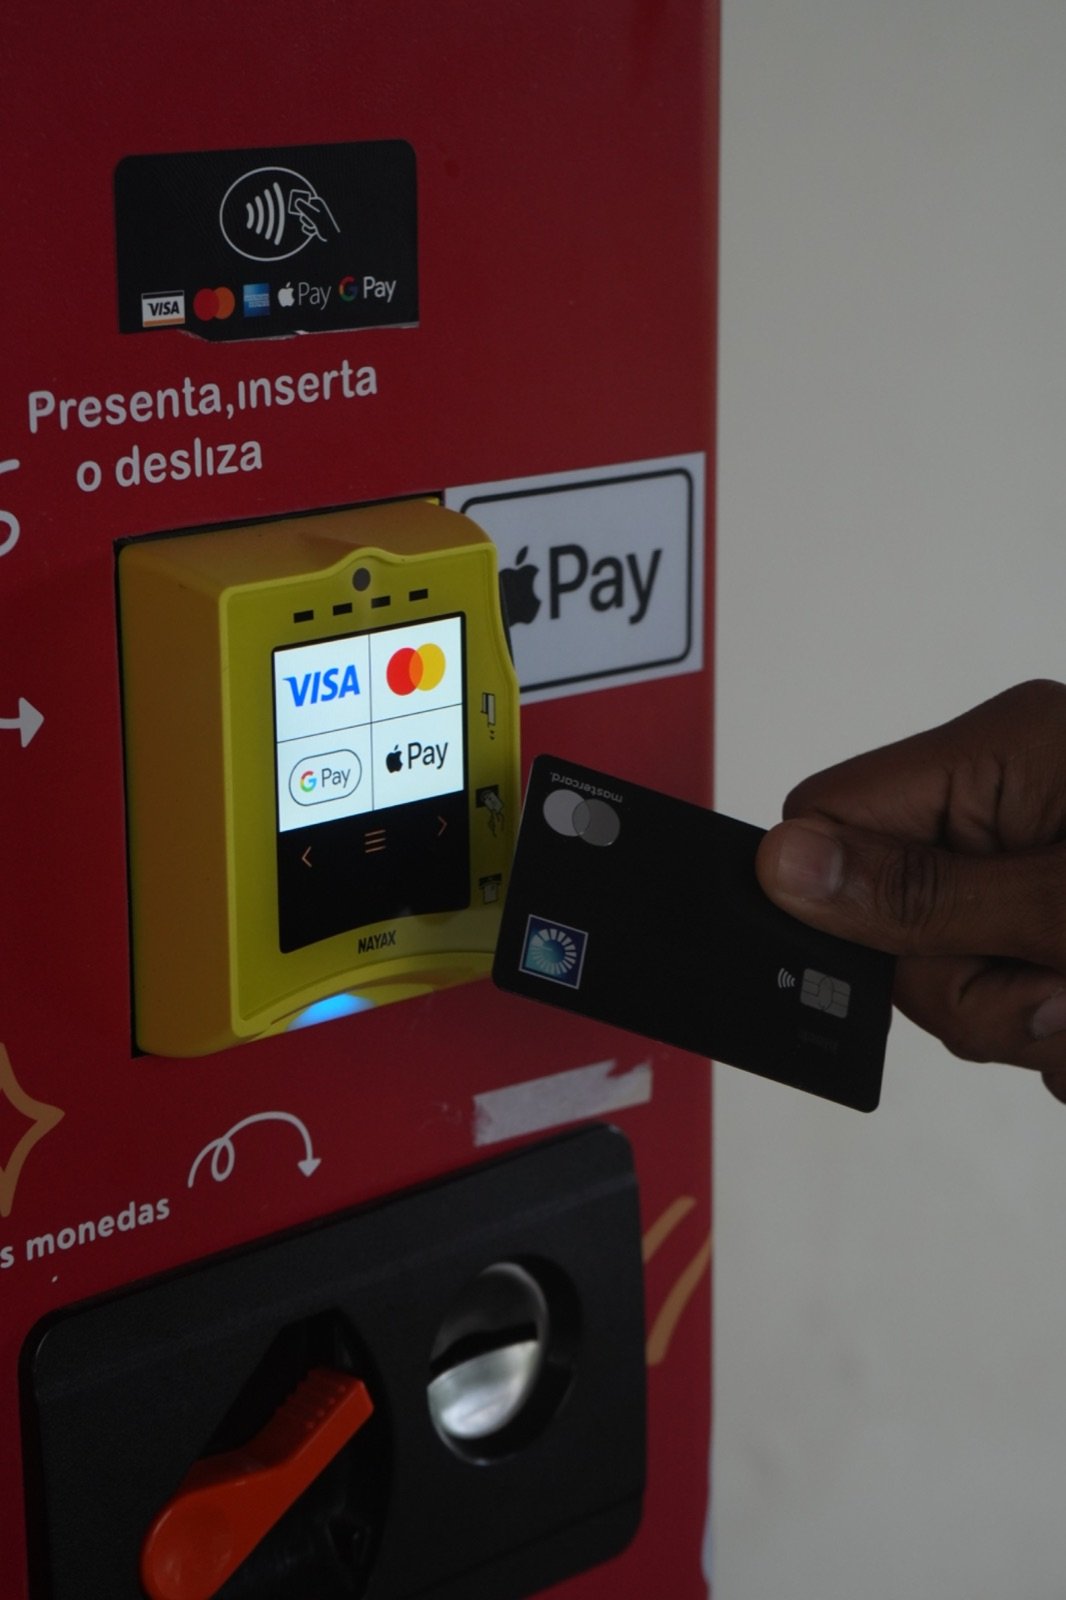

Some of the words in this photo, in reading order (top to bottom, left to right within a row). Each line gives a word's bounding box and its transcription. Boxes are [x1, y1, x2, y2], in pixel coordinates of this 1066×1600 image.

[147, 300, 180, 317] VISA
[298, 281, 333, 311] Pay
[362, 275, 397, 303] Pay
[76, 460, 102, 492] o
[549, 543, 663, 626] Pay
[282, 664, 361, 707] VISA
[407, 742, 448, 770] Pay
[321, 767, 352, 789] Pay
[357, 929, 397, 955] NAYAX
[26, 1197, 171, 1262] monedas
